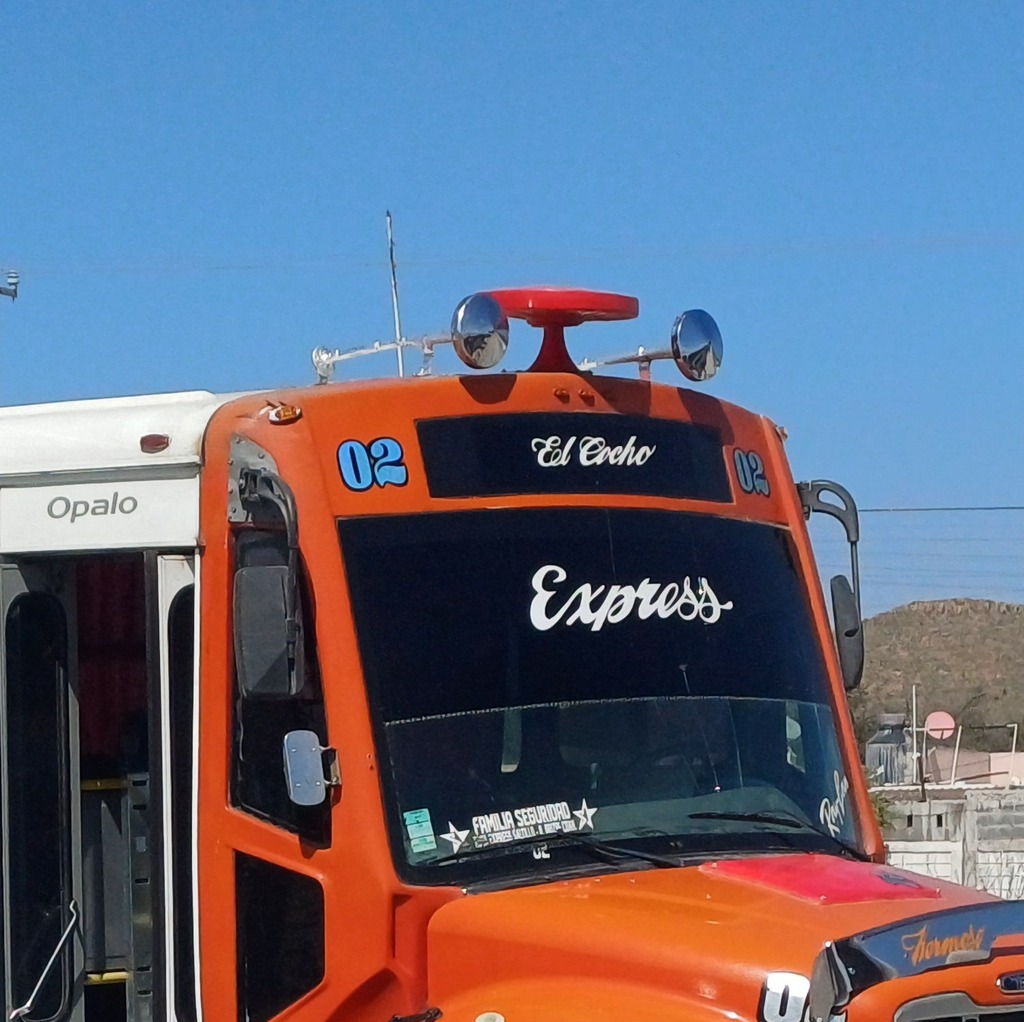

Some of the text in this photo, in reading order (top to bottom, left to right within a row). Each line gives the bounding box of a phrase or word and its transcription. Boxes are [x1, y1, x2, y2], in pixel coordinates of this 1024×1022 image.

[337, 437, 408, 492] 02
[531, 435, 577, 467] El
[733, 448, 770, 498] 02
[47, 491, 138, 523] Opalo
[530, 565, 733, 631] Express
[472, 812, 515, 834] FAMILIA
[514, 802, 570, 827] SEGURIDAD
